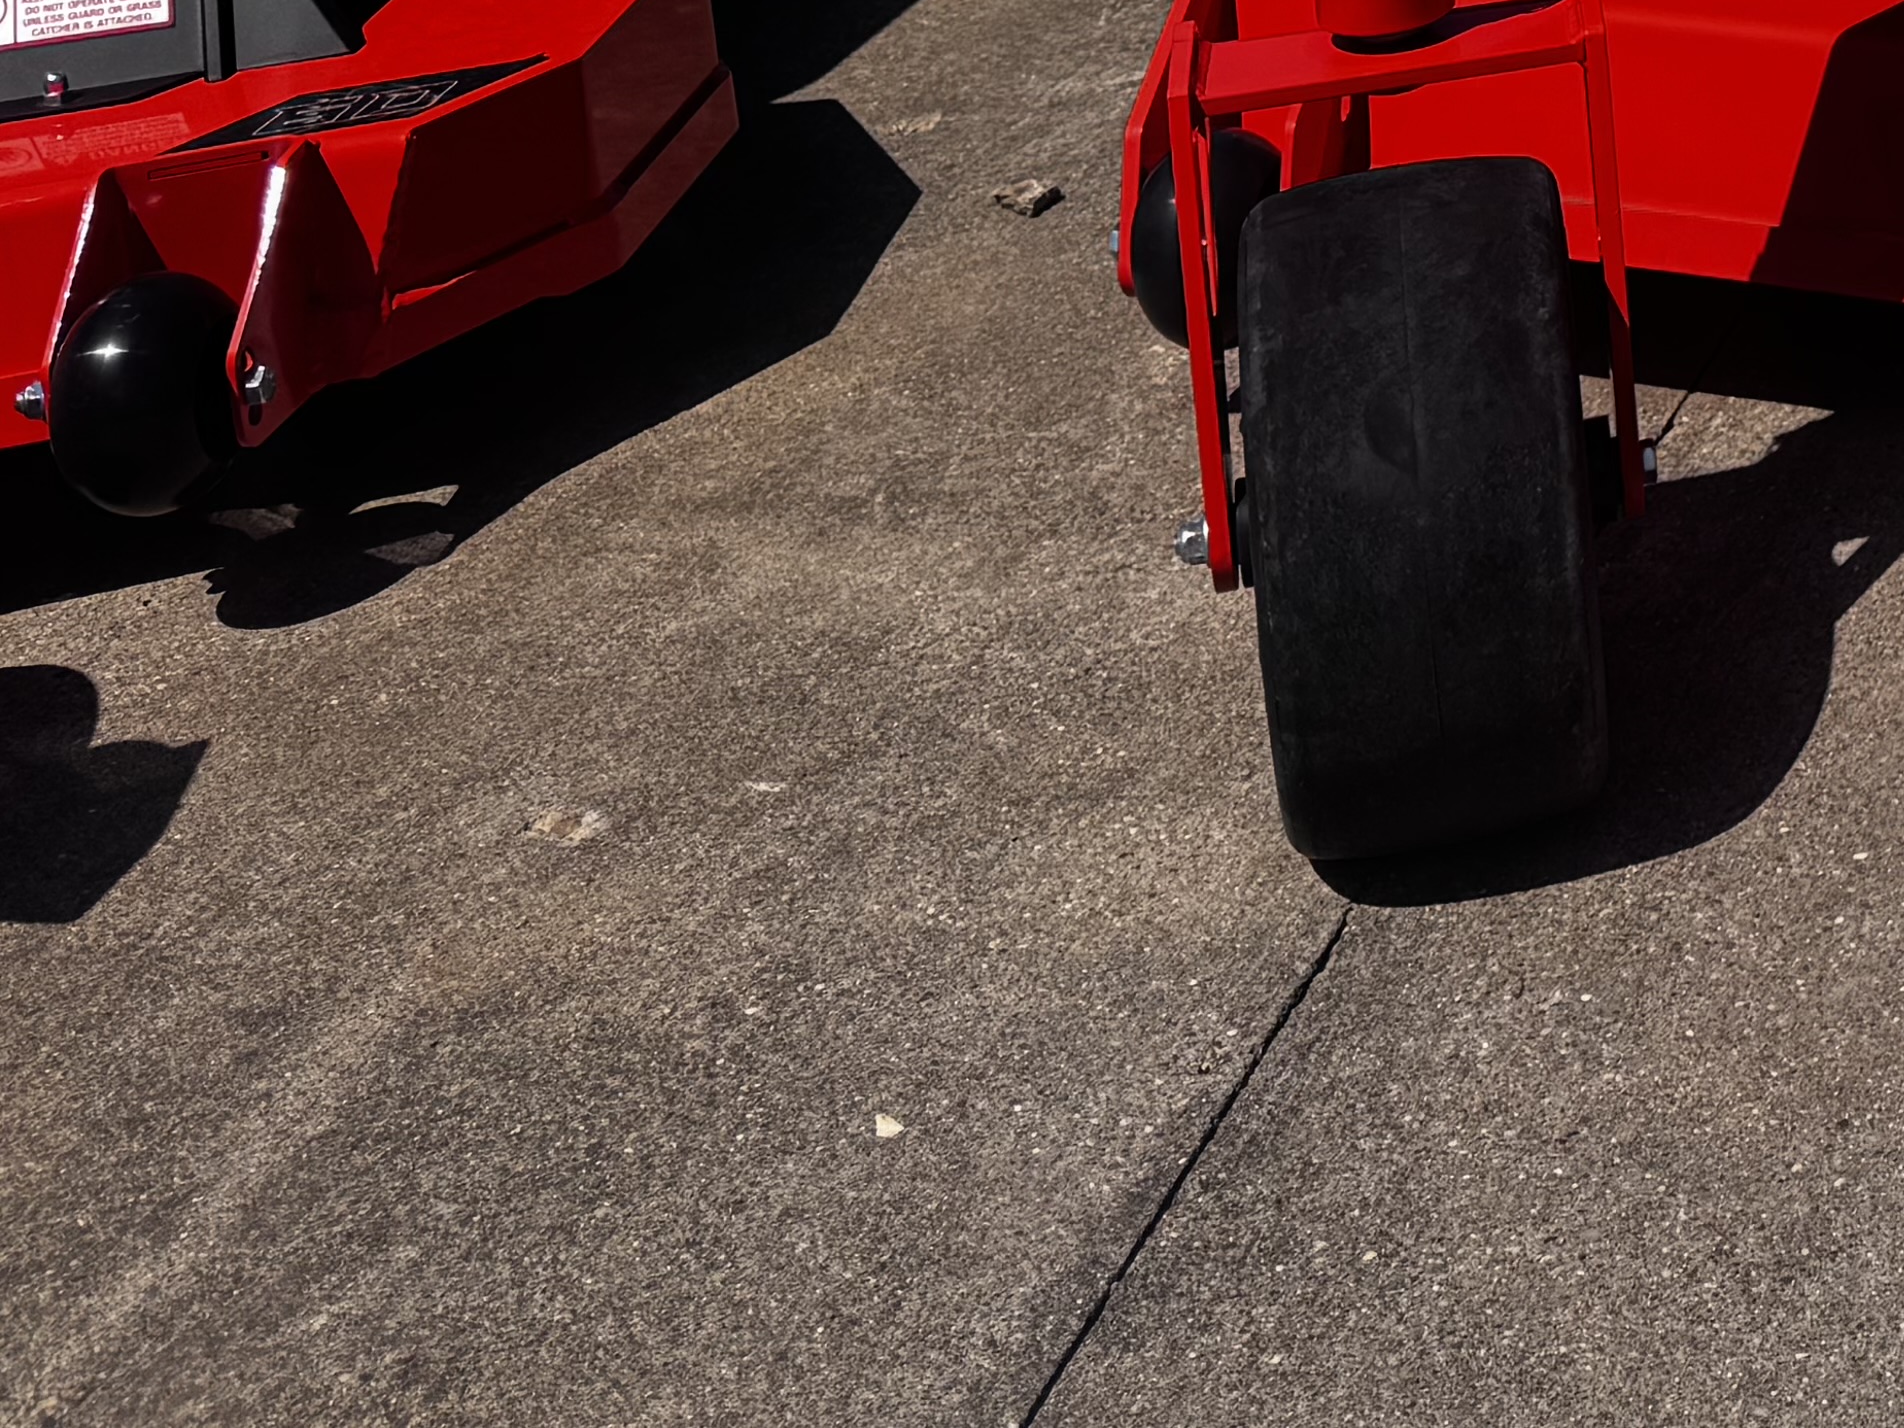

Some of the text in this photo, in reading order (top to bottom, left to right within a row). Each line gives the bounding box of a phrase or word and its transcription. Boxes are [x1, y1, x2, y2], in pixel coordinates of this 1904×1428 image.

[23, 0, 162, 27] UNLESS GUARD OR GRASS
[25, 4, 40, 15] DO
[43, 2, 63, 12] NOT
[32, 23, 80, 36] CATCHER
